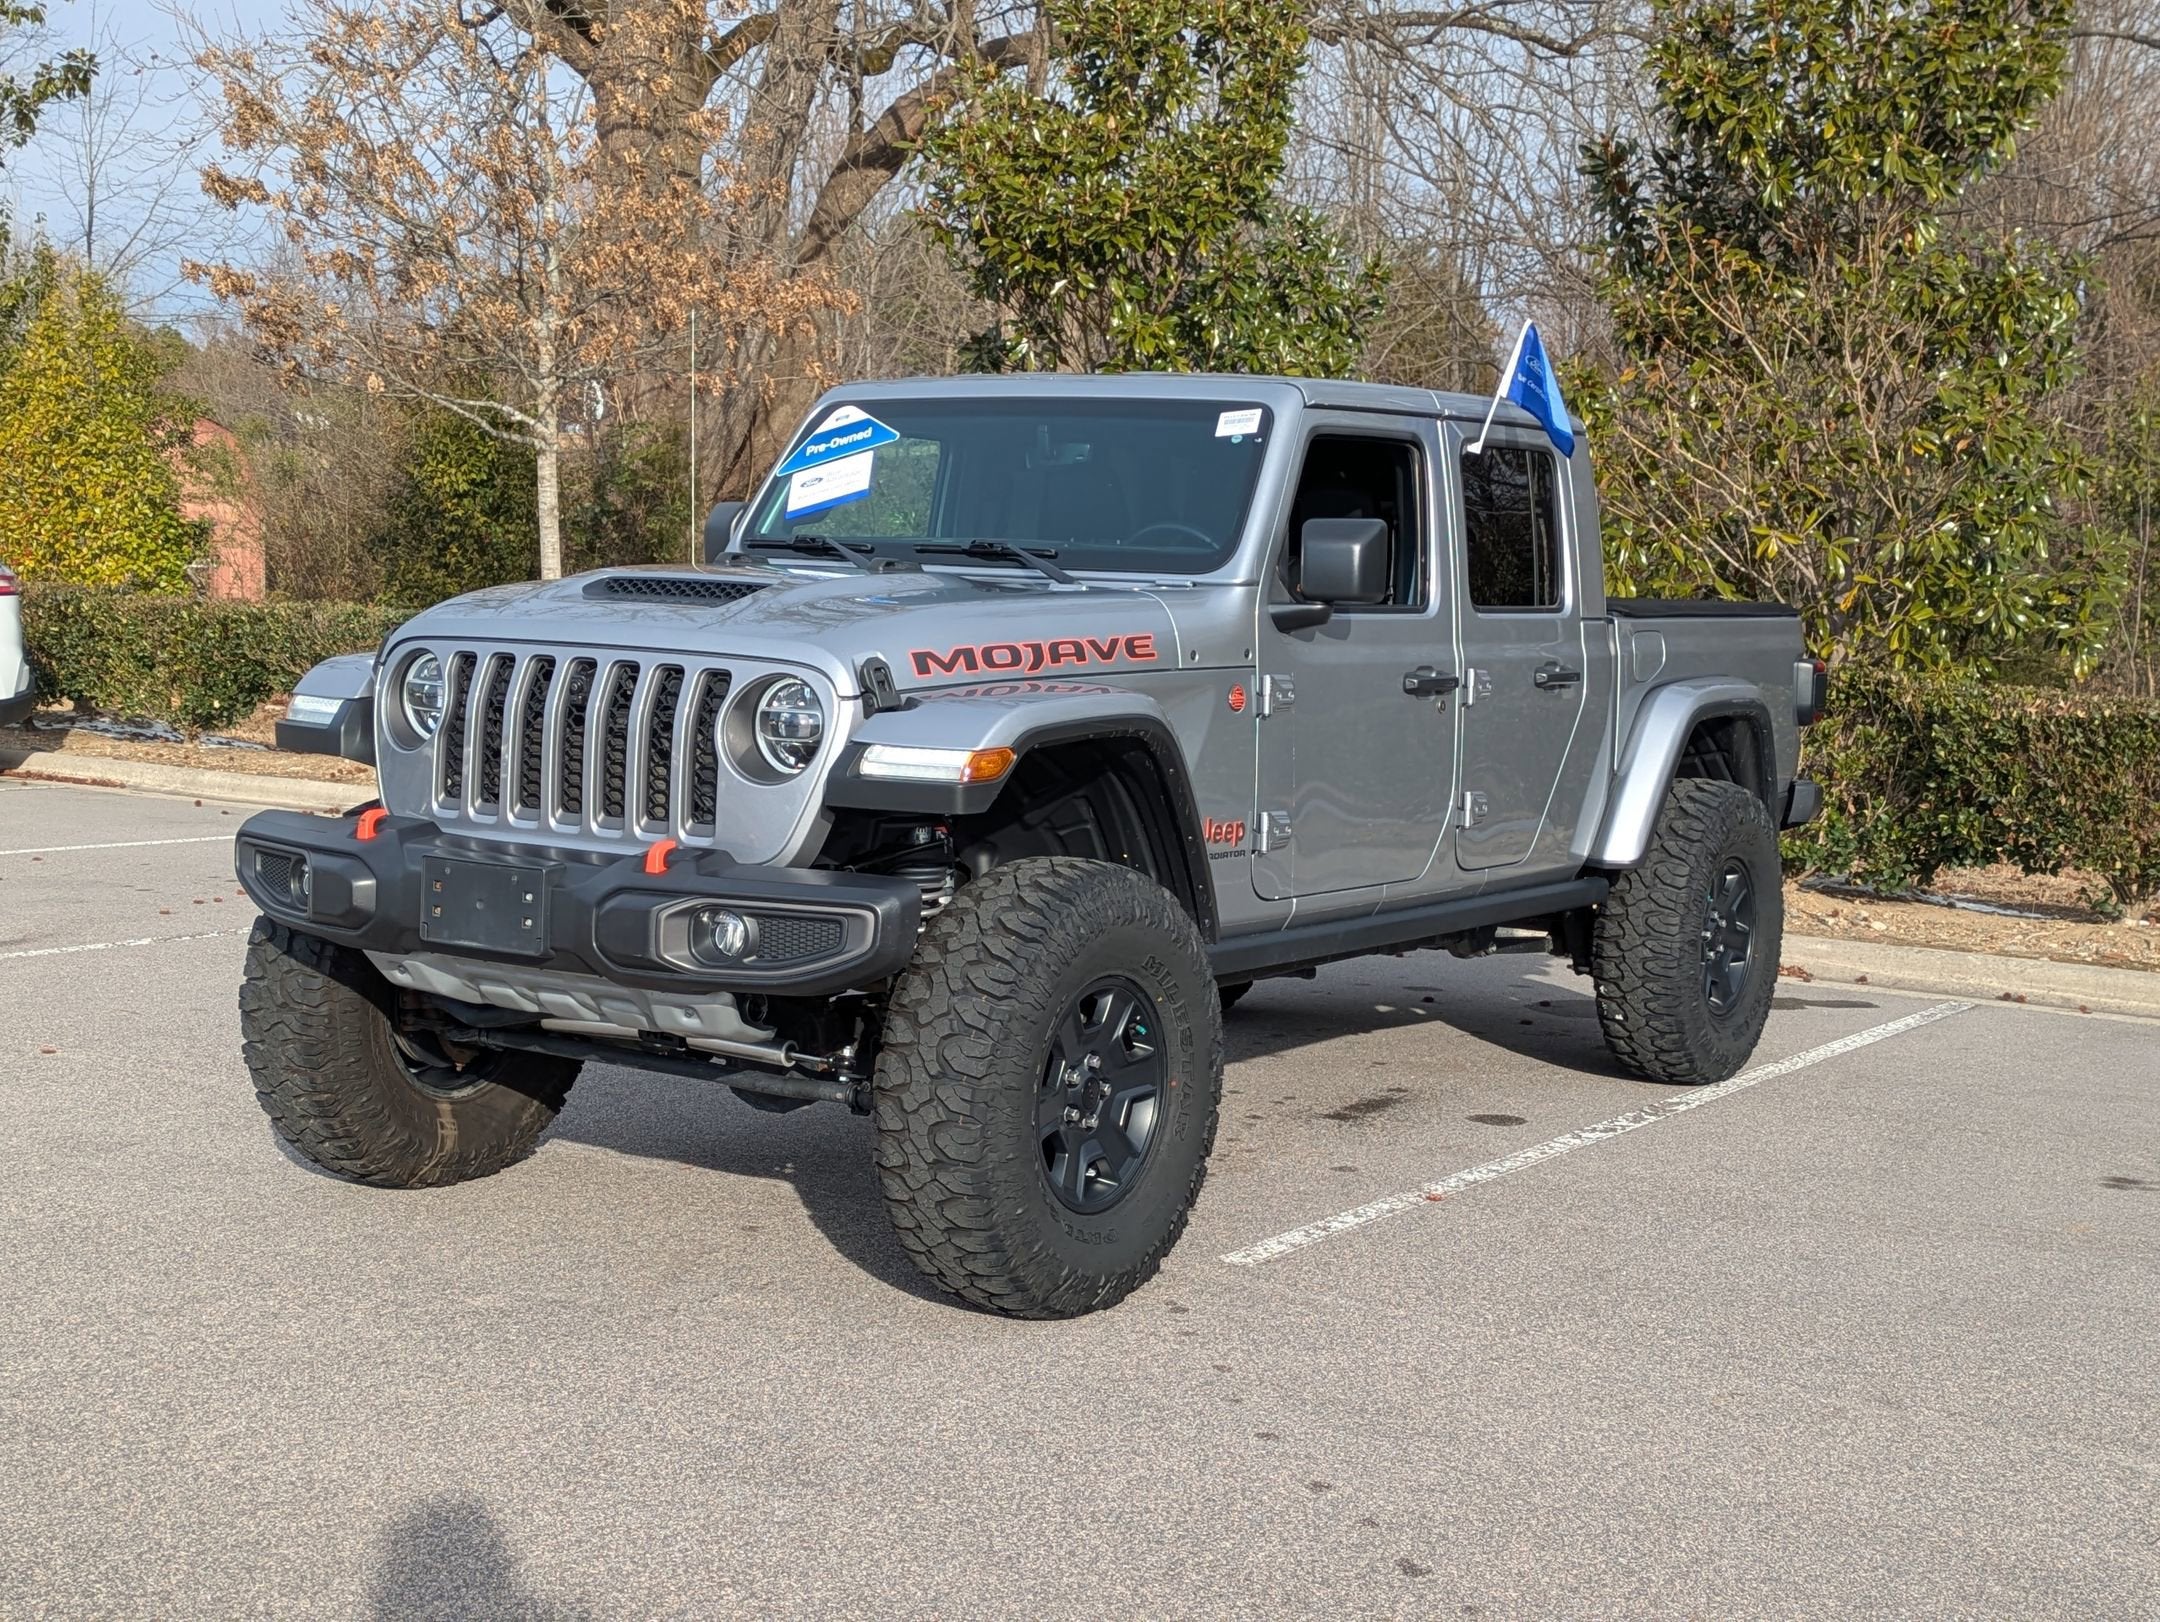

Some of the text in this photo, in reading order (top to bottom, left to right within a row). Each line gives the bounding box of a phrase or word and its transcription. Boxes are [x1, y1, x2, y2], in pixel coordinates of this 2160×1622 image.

[805, 426, 873, 457] Pre-Owned
[910, 633, 1157, 677] MOJAVE
[1204, 816, 1246, 848] Jeep
[1141, 953, 1195, 1141] MILESTAR
